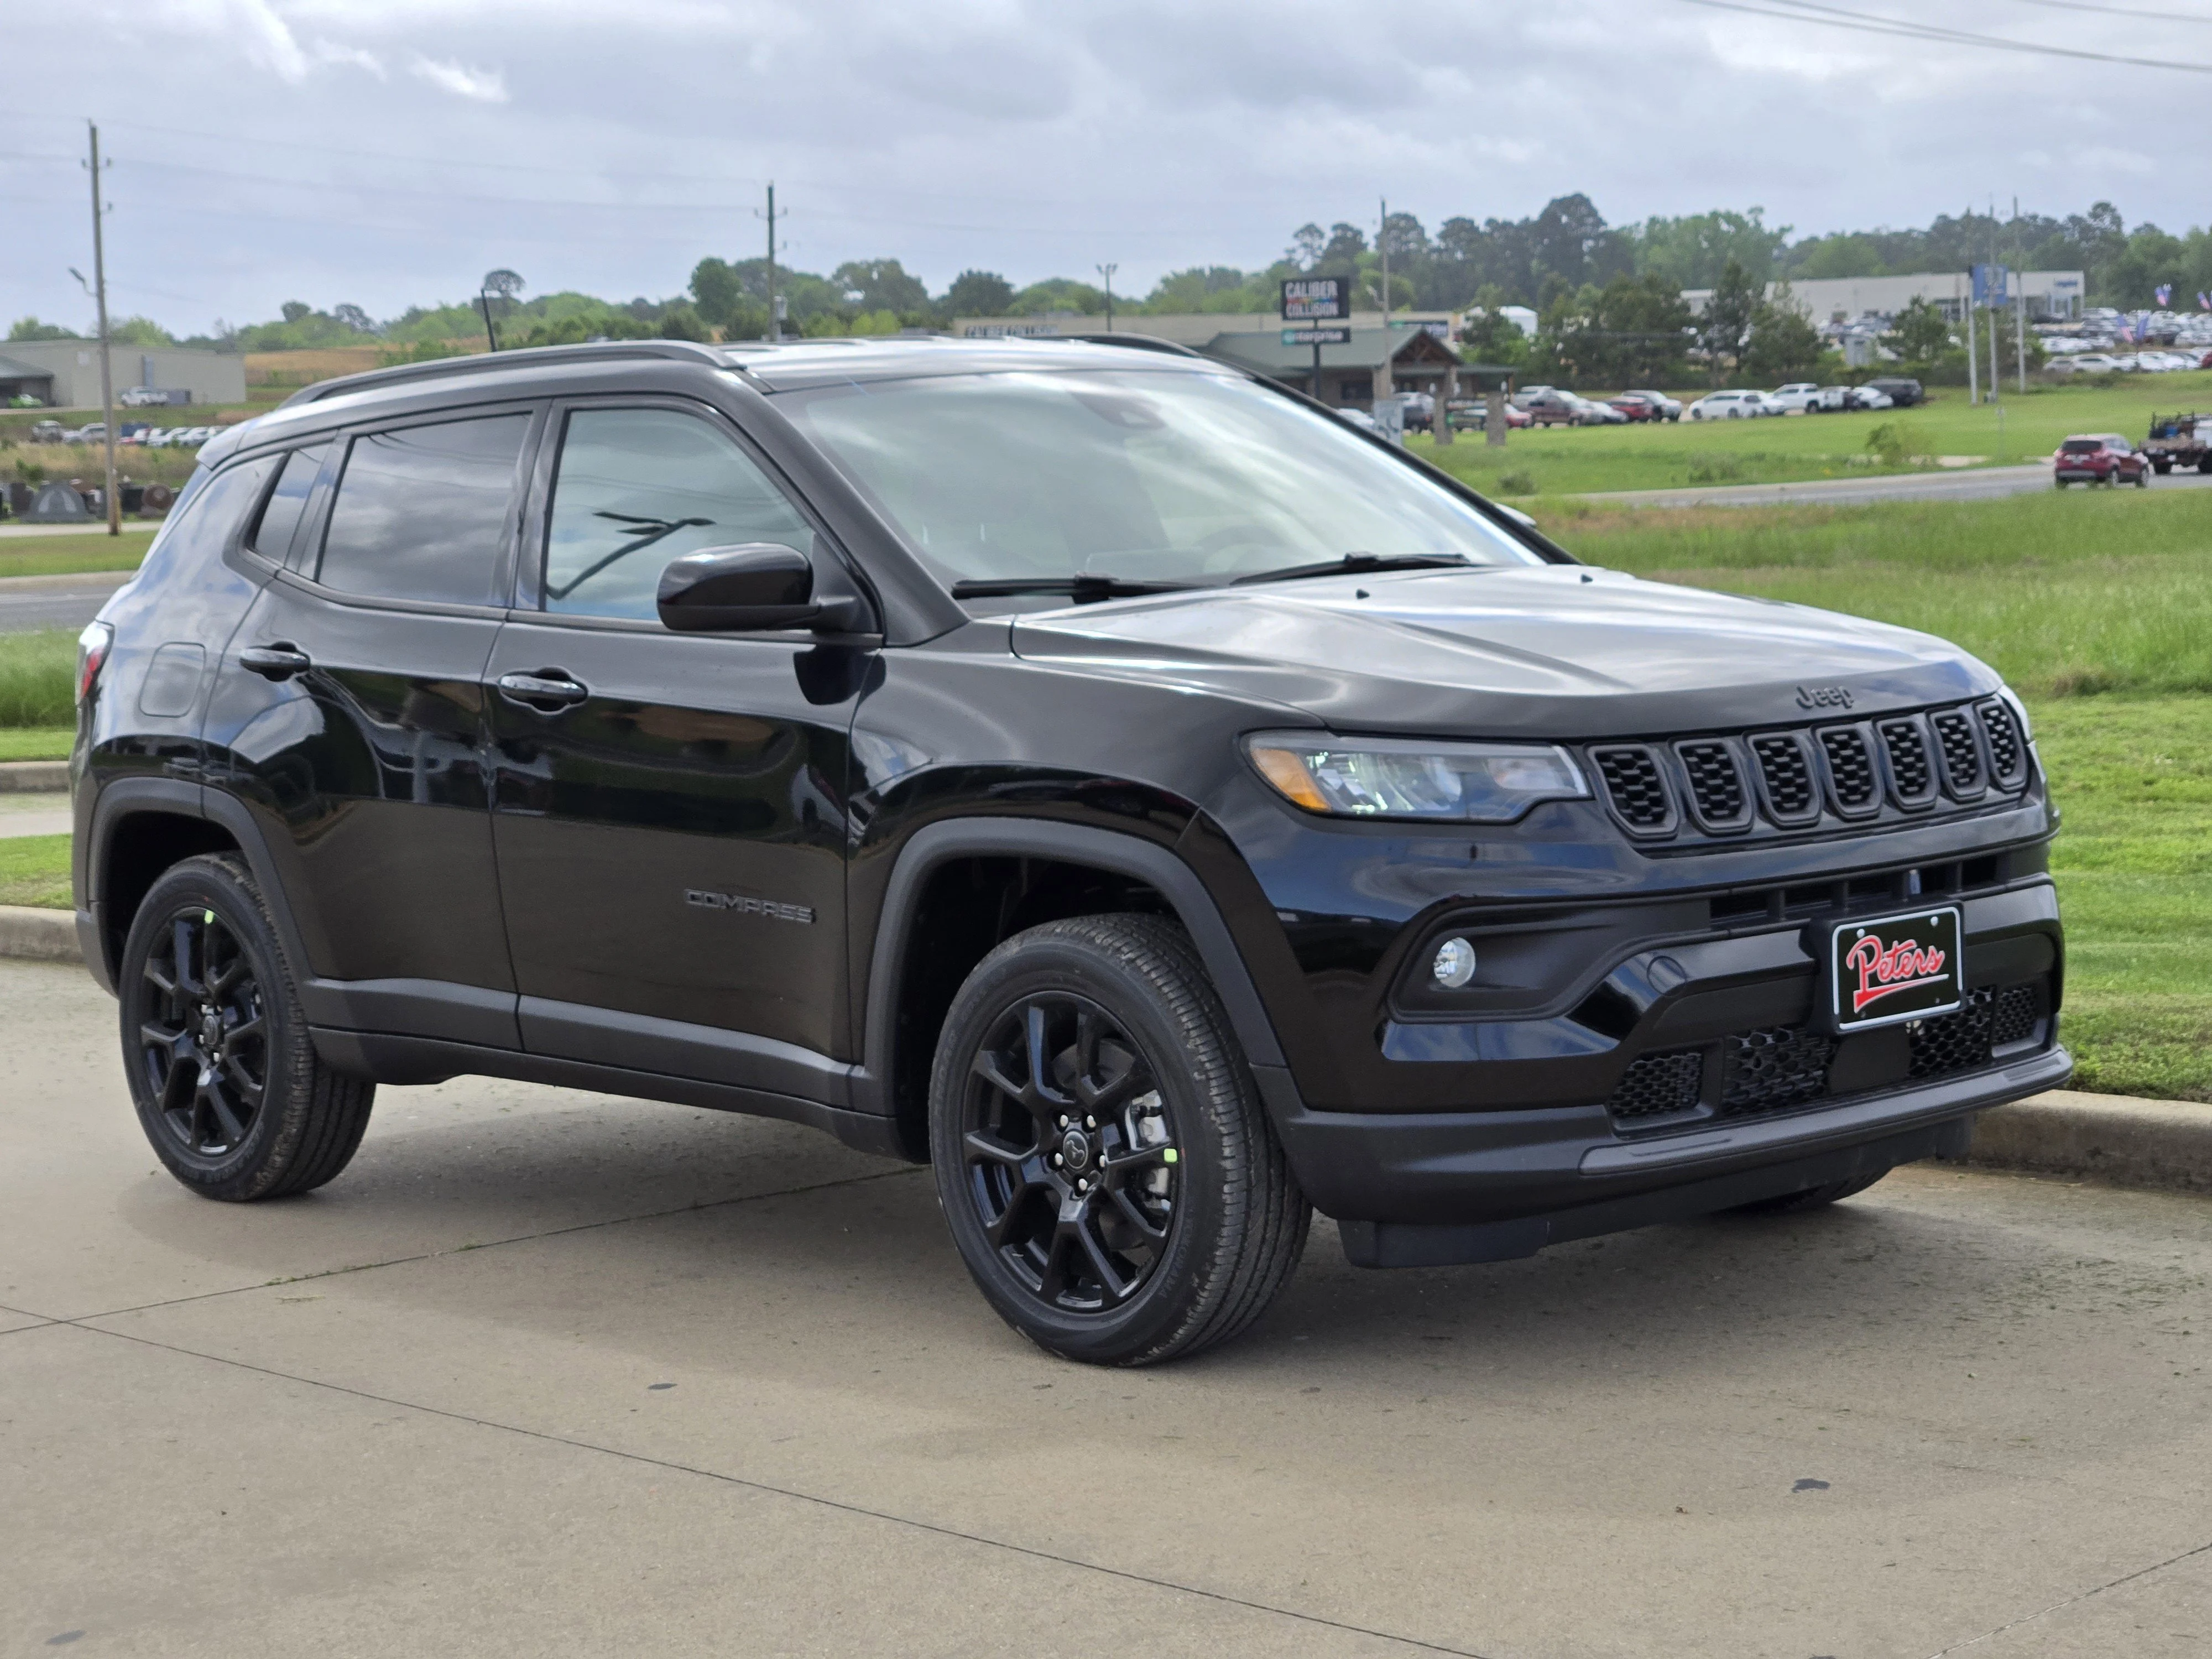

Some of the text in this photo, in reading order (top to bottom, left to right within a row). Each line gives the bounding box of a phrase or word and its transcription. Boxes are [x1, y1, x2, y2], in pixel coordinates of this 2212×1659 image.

[1286, 280, 1338, 299] CALIBER
[1286, 302, 1339, 318] COLLISION
[1795, 686, 1855, 709] Jeep
[684, 888, 816, 924] COMPASS
[1846, 935, 1946, 995] Peters
